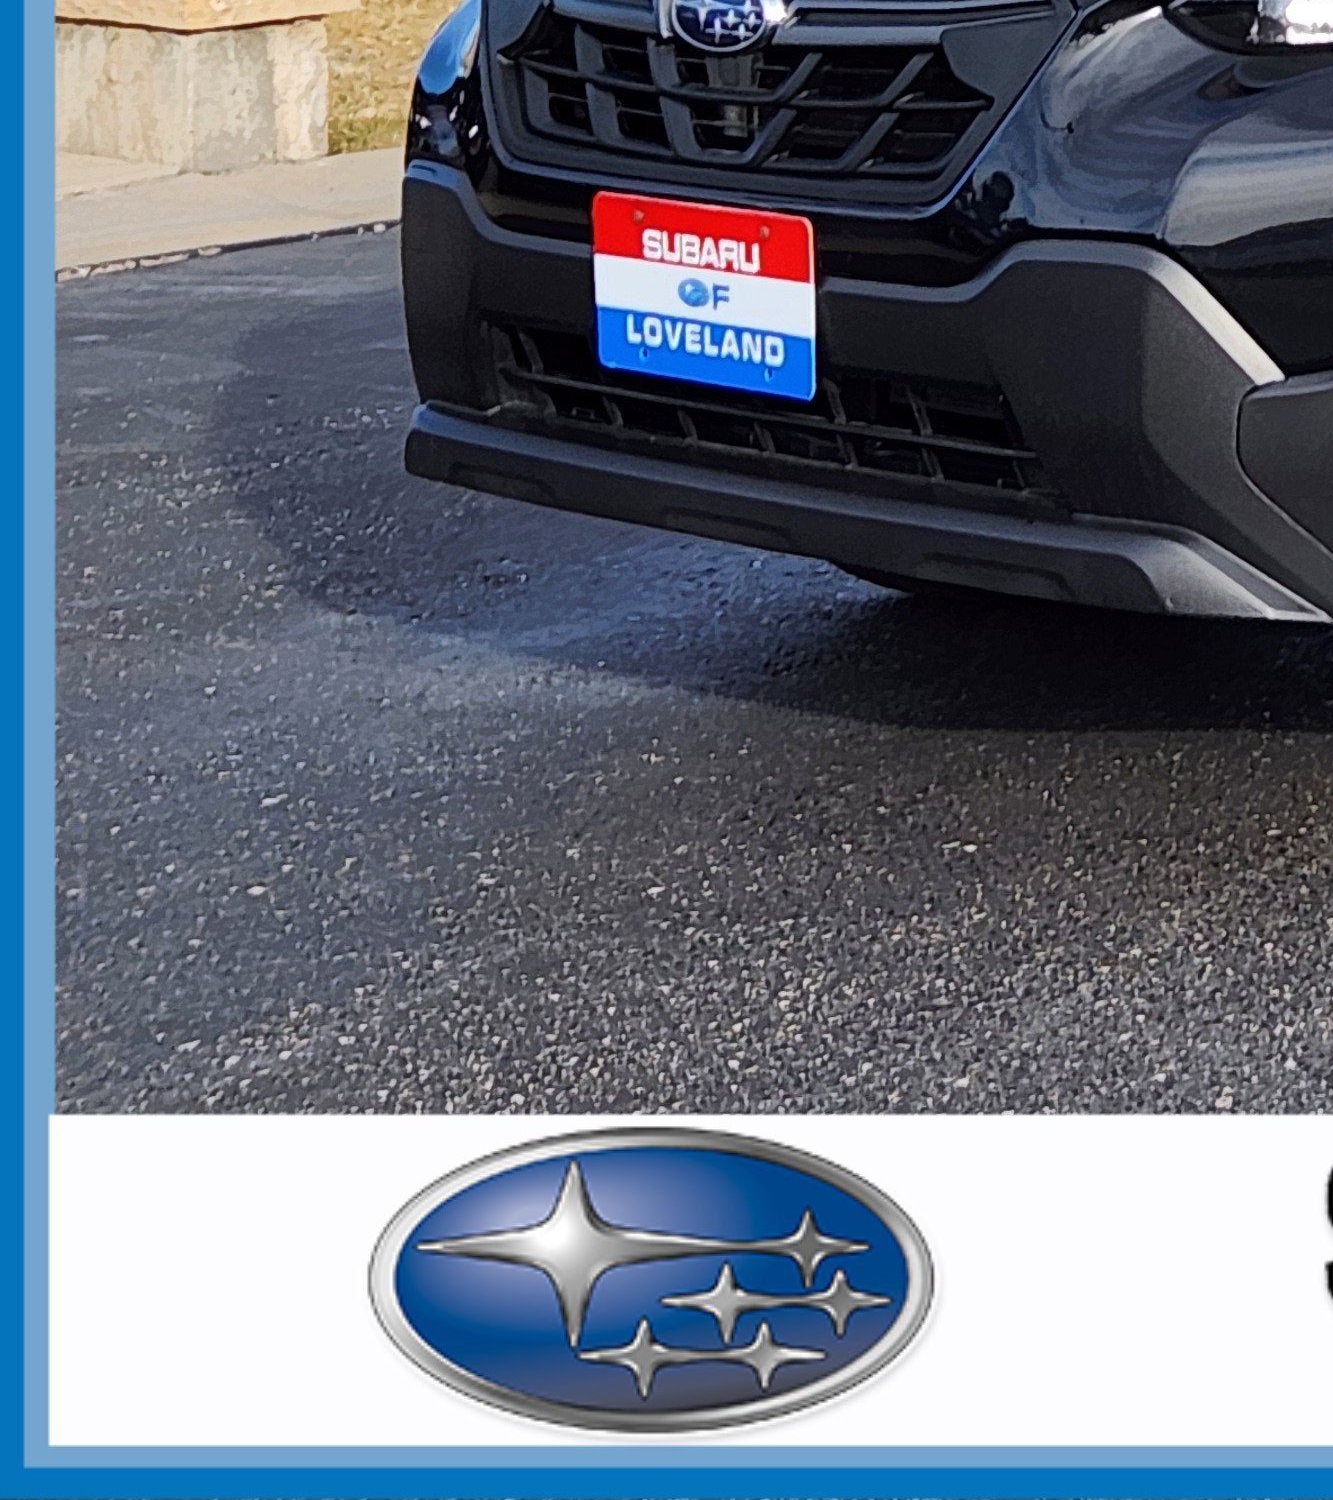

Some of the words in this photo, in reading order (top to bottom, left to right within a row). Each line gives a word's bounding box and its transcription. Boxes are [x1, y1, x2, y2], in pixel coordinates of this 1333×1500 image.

[641, 228, 761, 274] SUBARU
[677, 277, 730, 311] OF
[626, 313, 785, 368] LOVELAND
